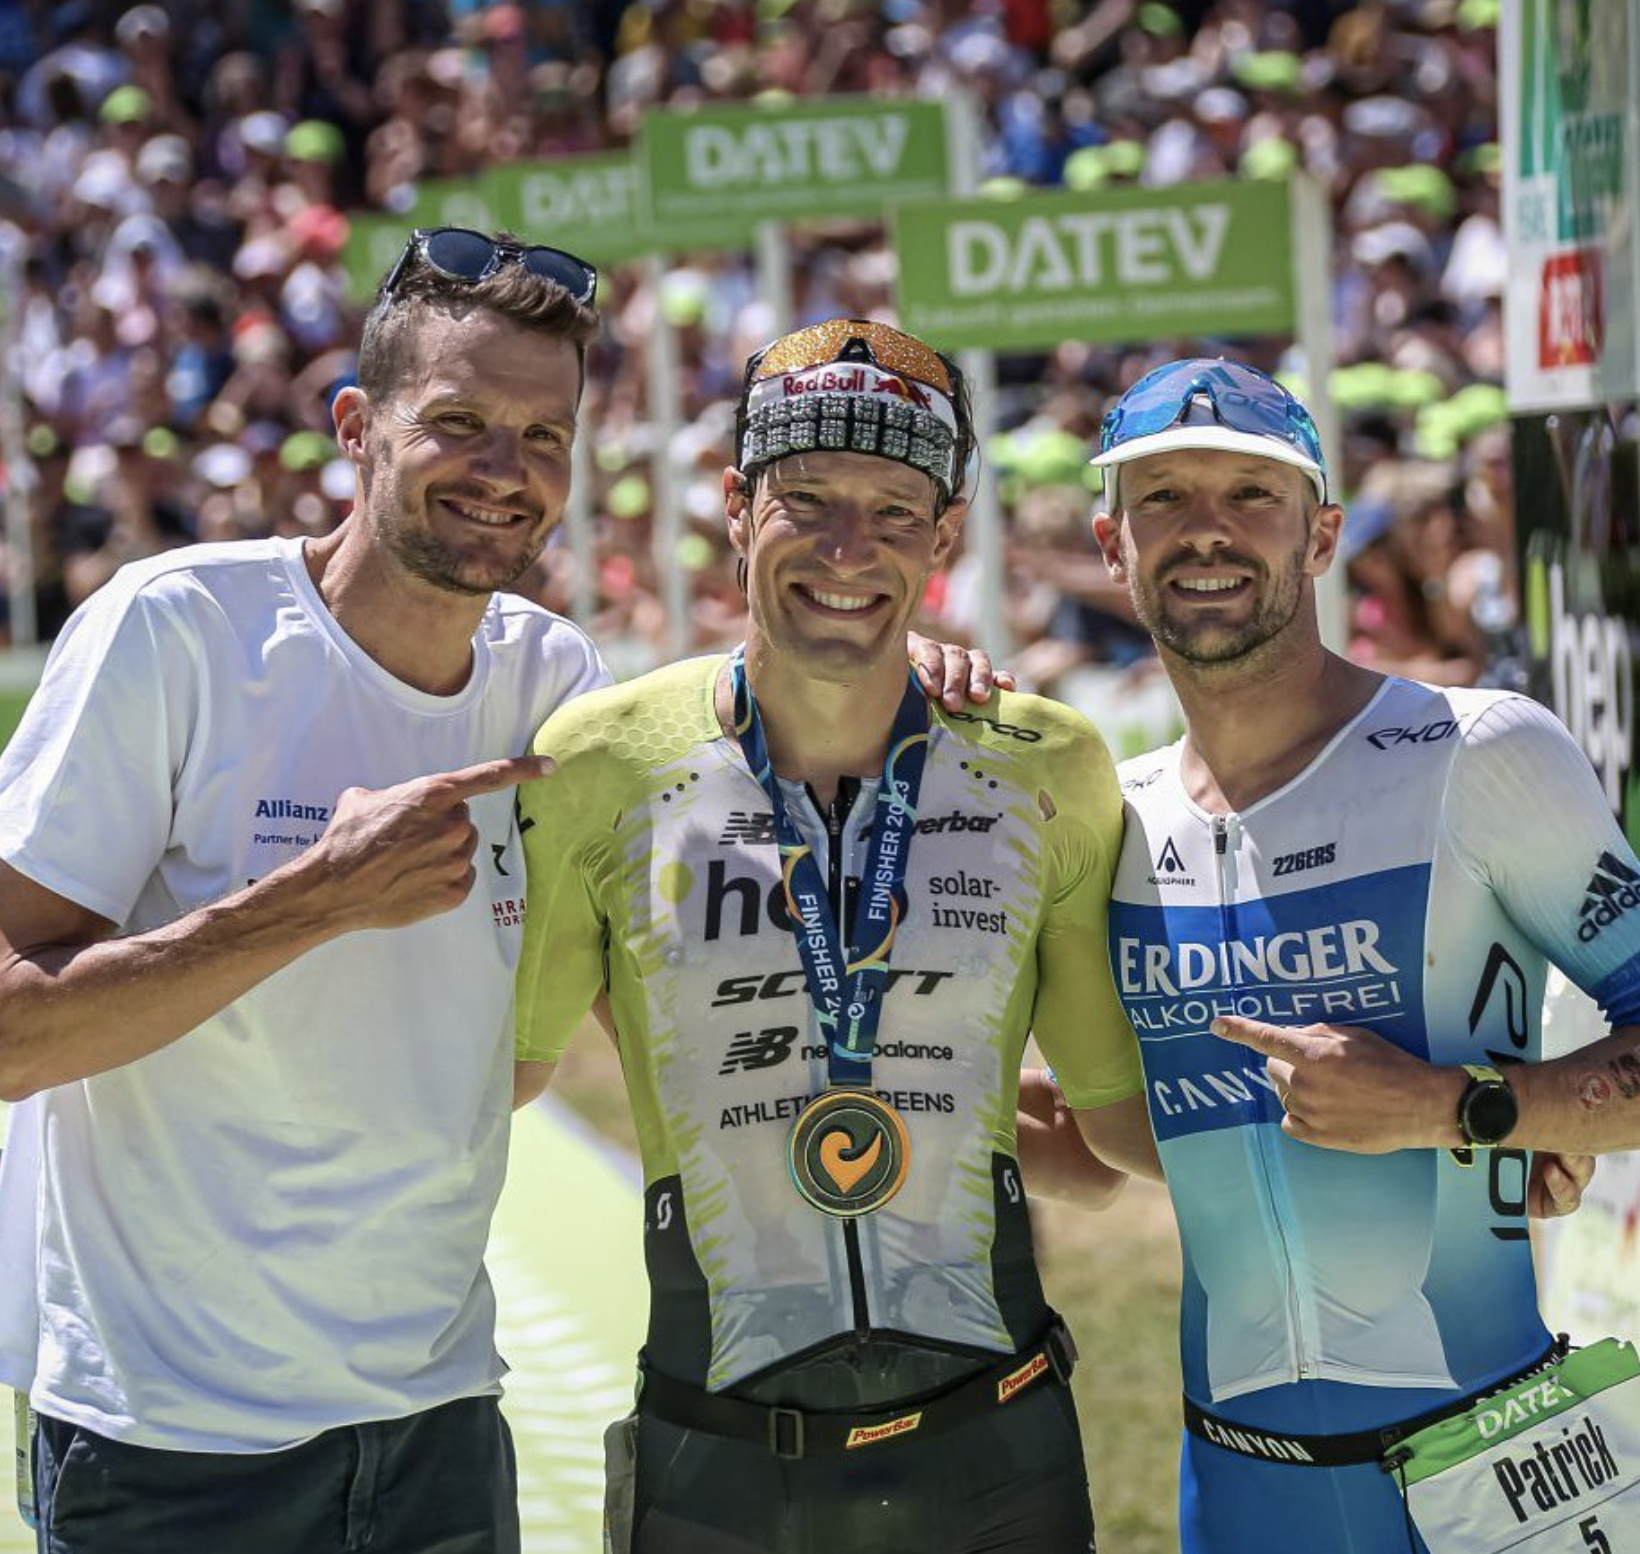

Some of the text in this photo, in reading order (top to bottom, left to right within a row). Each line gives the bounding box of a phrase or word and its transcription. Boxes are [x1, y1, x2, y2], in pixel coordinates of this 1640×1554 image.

[685, 115, 908, 187] DATEV
[523, 166, 638, 227] DAT
[947, 203, 1231, 296] DATEV
[783, 369, 865, 396] Red Bull
[255, 799, 328, 822] Allianz
[254, 834, 293, 845] Partner
[296, 835, 310, 846] for
[868, 780, 910, 920] FINISHER 2023
[1272, 842, 1337, 877] 226ERS
[929, 869, 1001, 899] solar-
[932, 902, 1007, 935] invest
[1578, 884, 1640, 943] adid
[799, 894, 839, 992] FINISHER
[1119, 920, 1400, 997] ERDINGER
[711, 970, 954, 1008] SCTT
[1131, 980, 1401, 1030] ALKOHOLFREI
[801, 1042, 829, 1061] ne
[720, 1090, 955, 1129] ATHLET EENS
[1154, 1067, 1276, 1116] CANY
[1203, 1418, 1315, 1462] CANYON
[1493, 1416, 1620, 1523] Patrick
